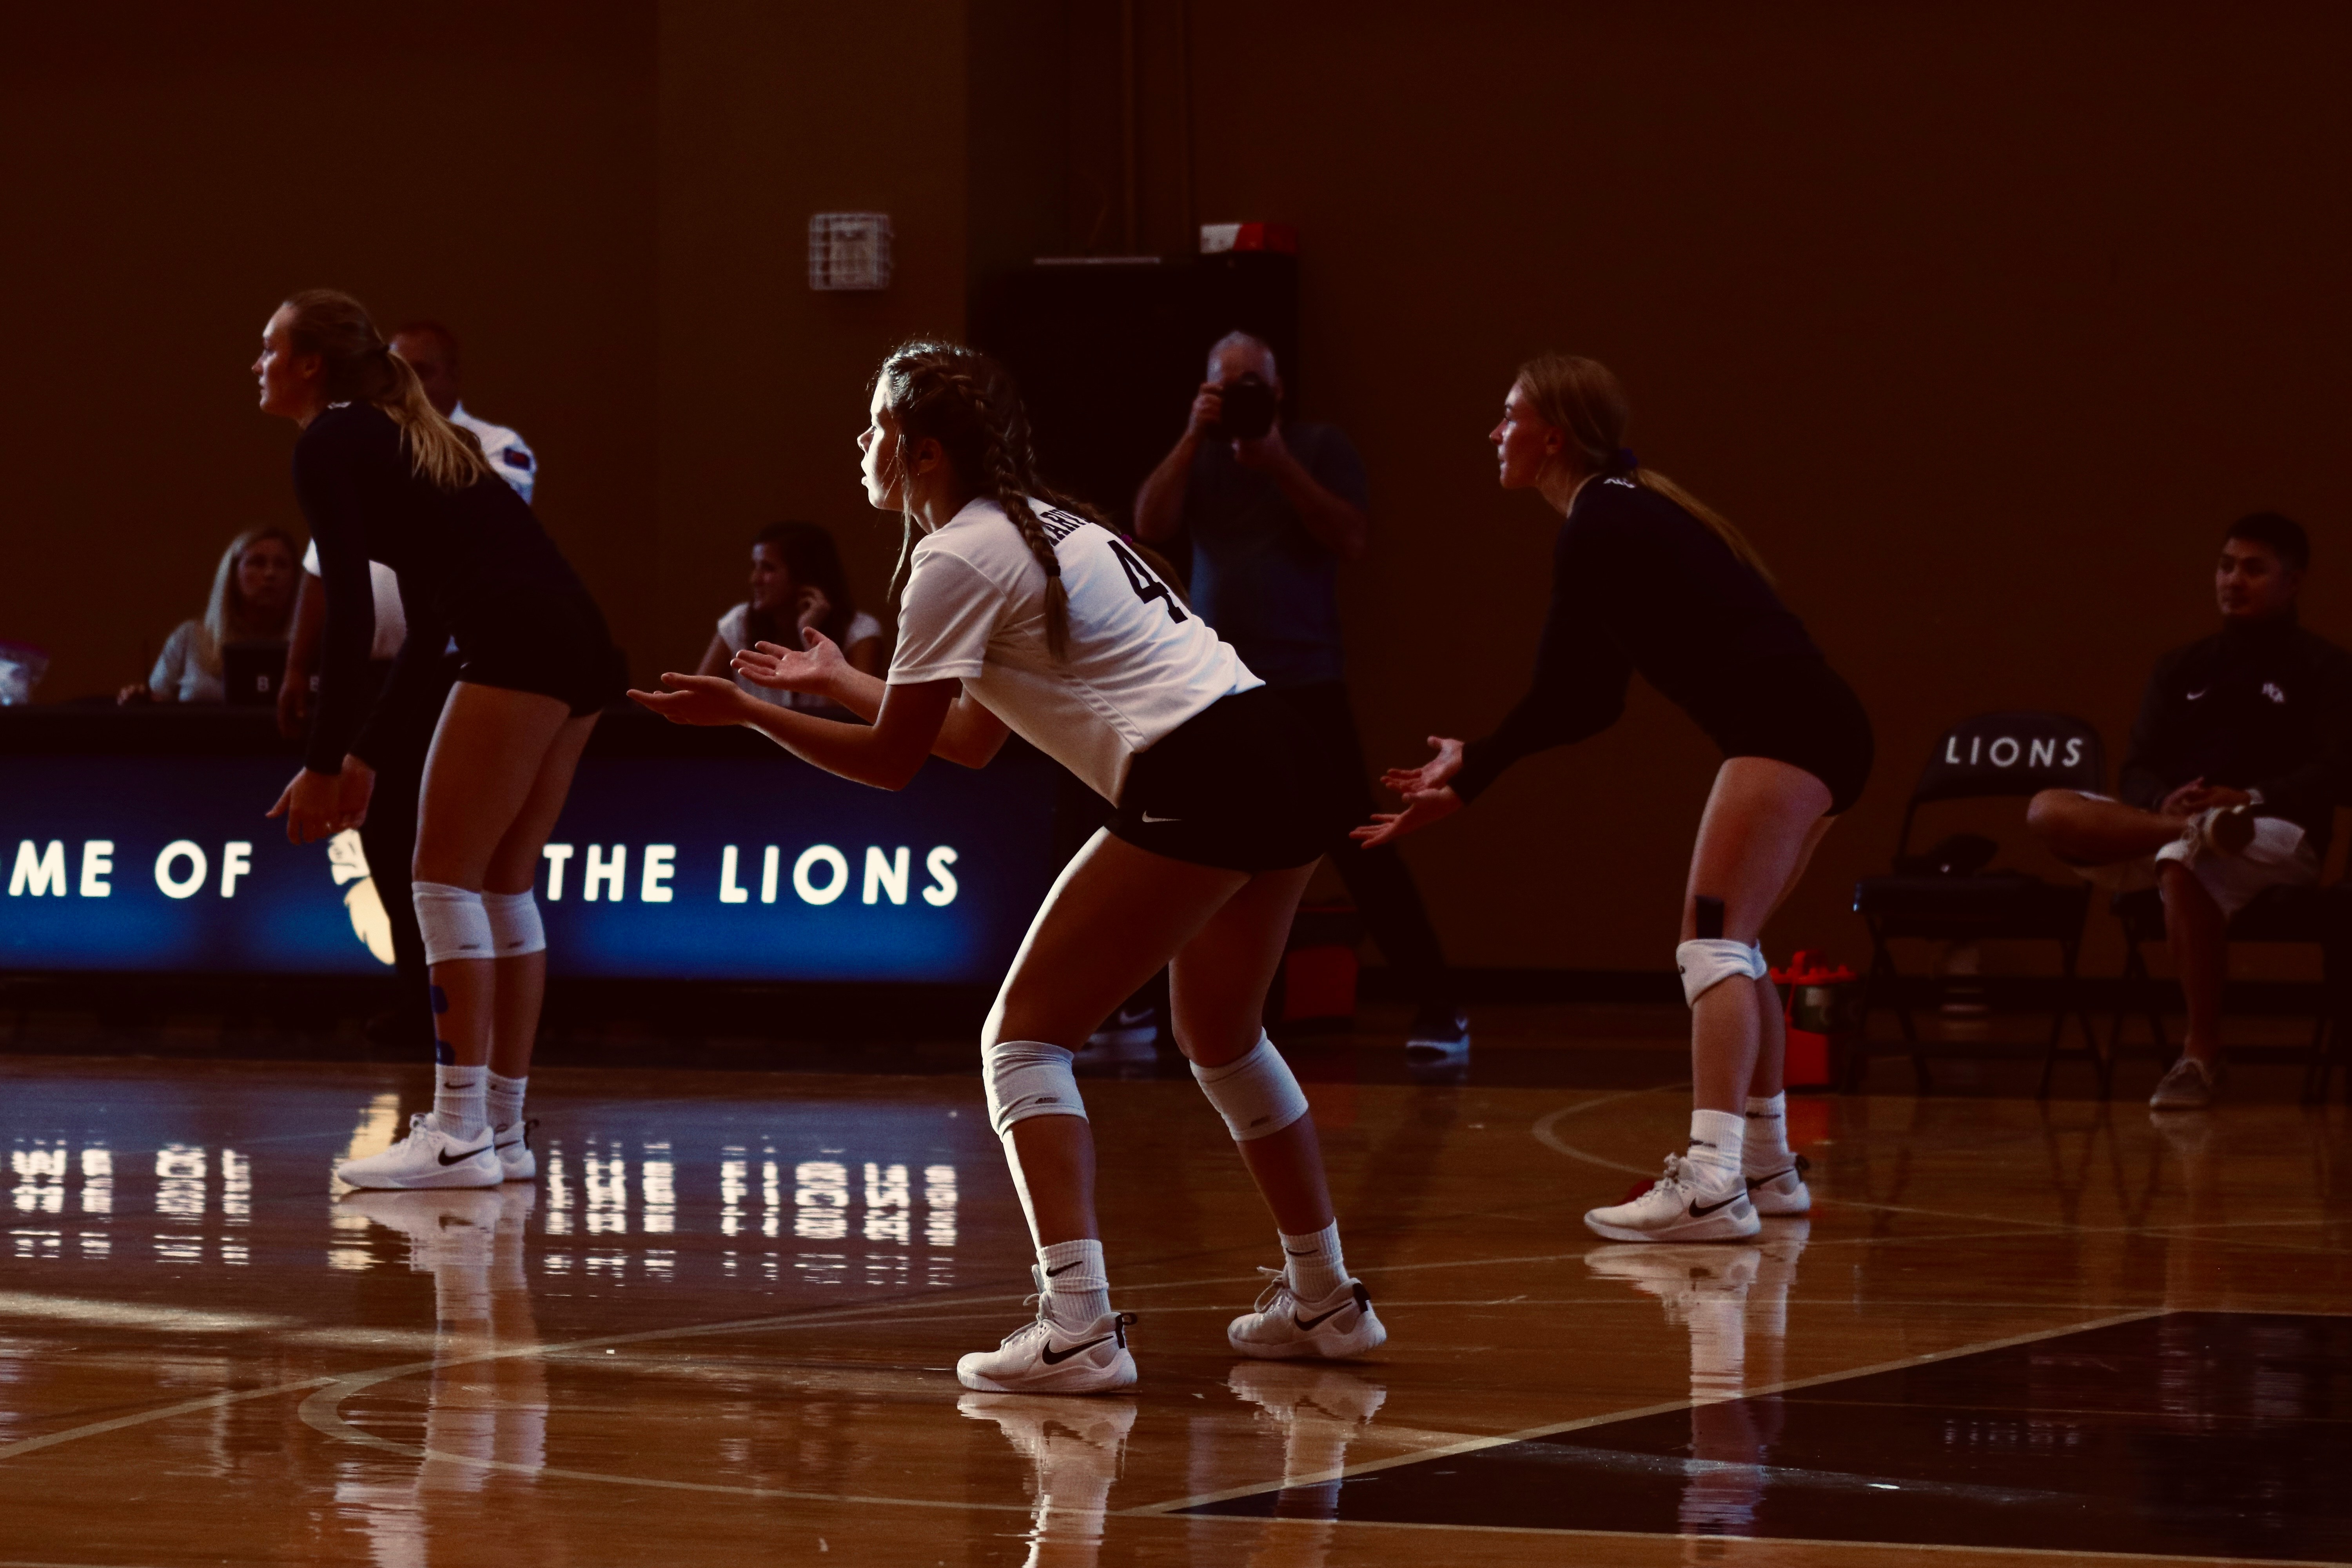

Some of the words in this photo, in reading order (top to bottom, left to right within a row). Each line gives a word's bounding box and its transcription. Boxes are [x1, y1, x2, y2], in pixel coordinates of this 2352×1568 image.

[1107, 540, 1188, 624] 4
[1945, 735, 2083, 768] LIONS
[154, 839, 253, 899] OF
[542, 843, 677, 903] THE
[719, 844, 958, 907] LIONS
